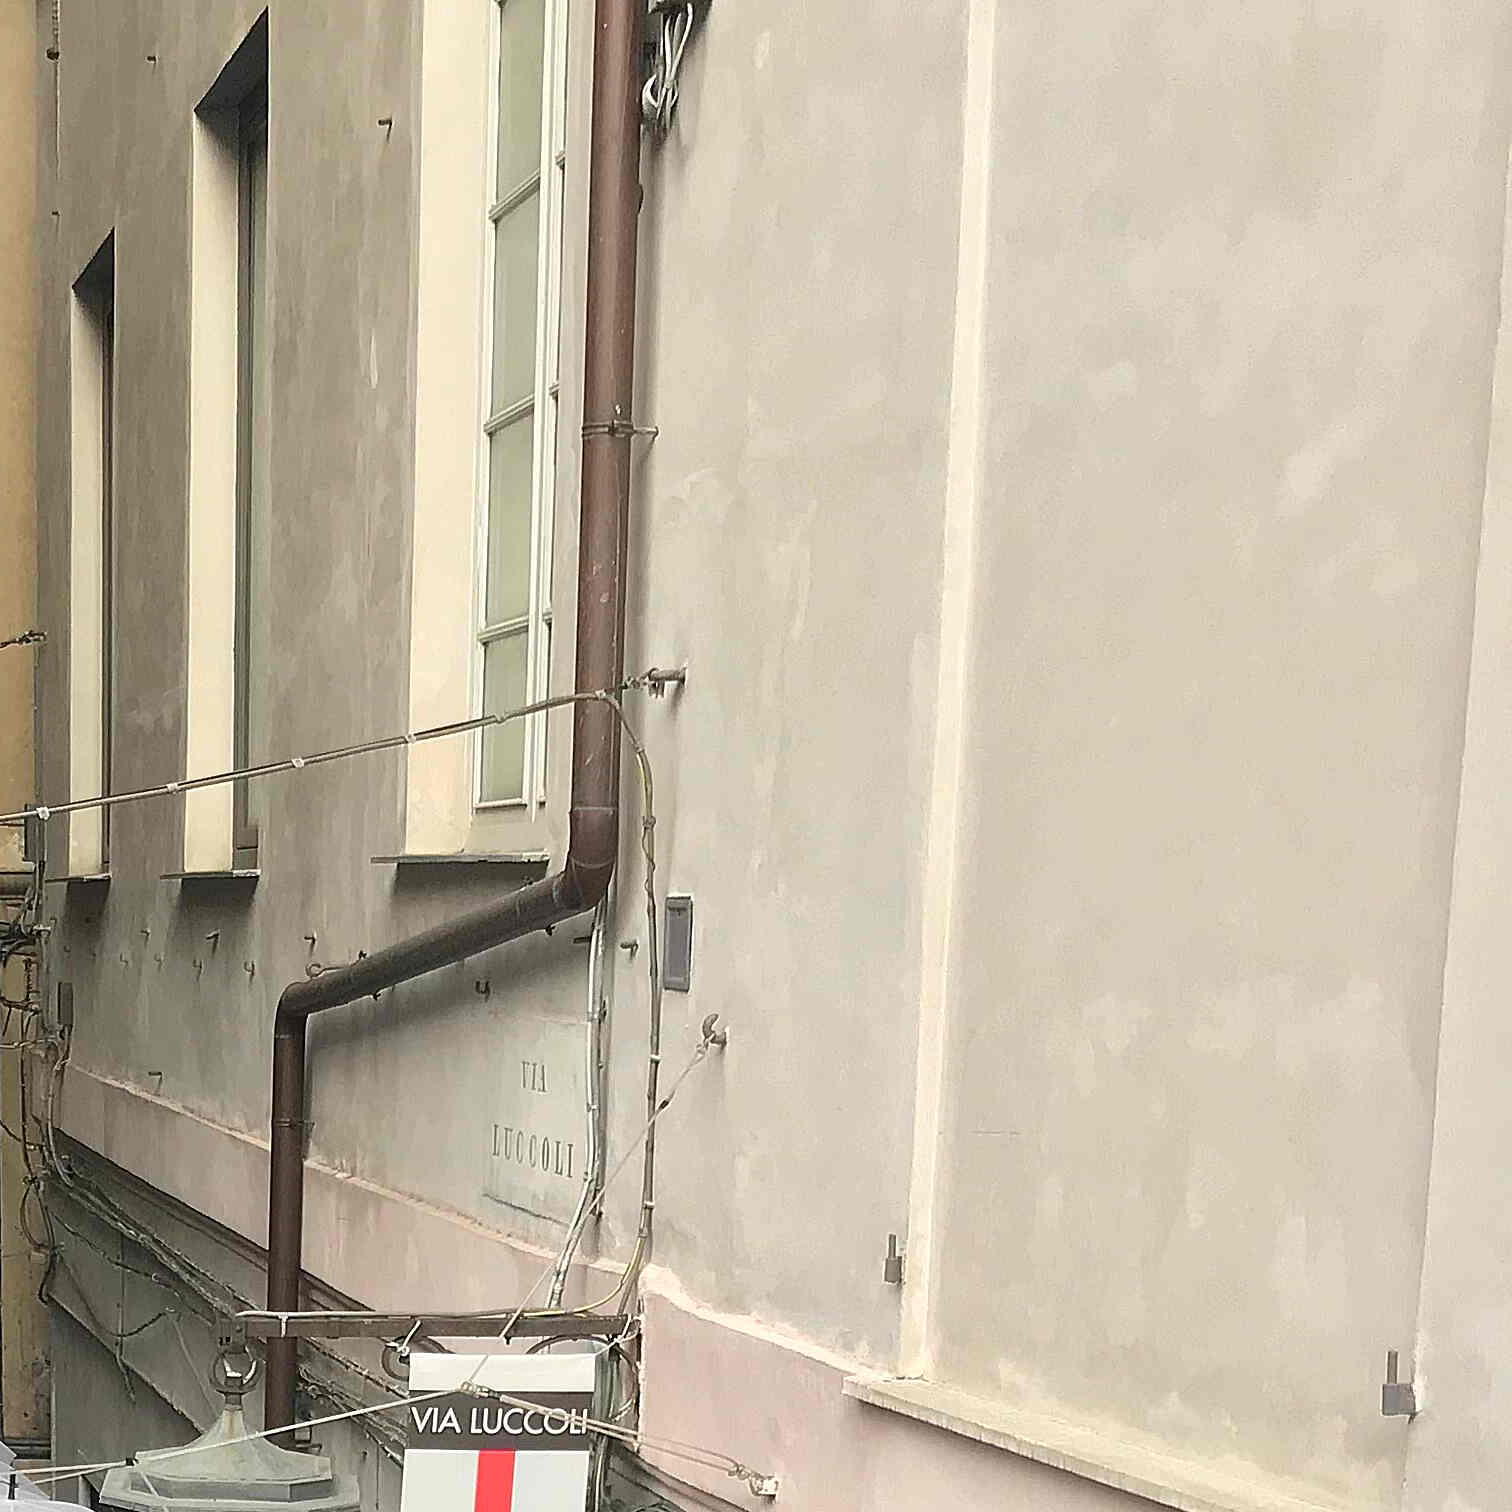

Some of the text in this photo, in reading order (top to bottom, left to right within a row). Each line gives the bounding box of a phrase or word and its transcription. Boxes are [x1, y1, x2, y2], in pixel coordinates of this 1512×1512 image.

[521, 1060, 548, 1093] VIA
[491, 1123, 573, 1179] LUCCOLI
[410, 1406, 589, 1435] VIA LUCCOLI
